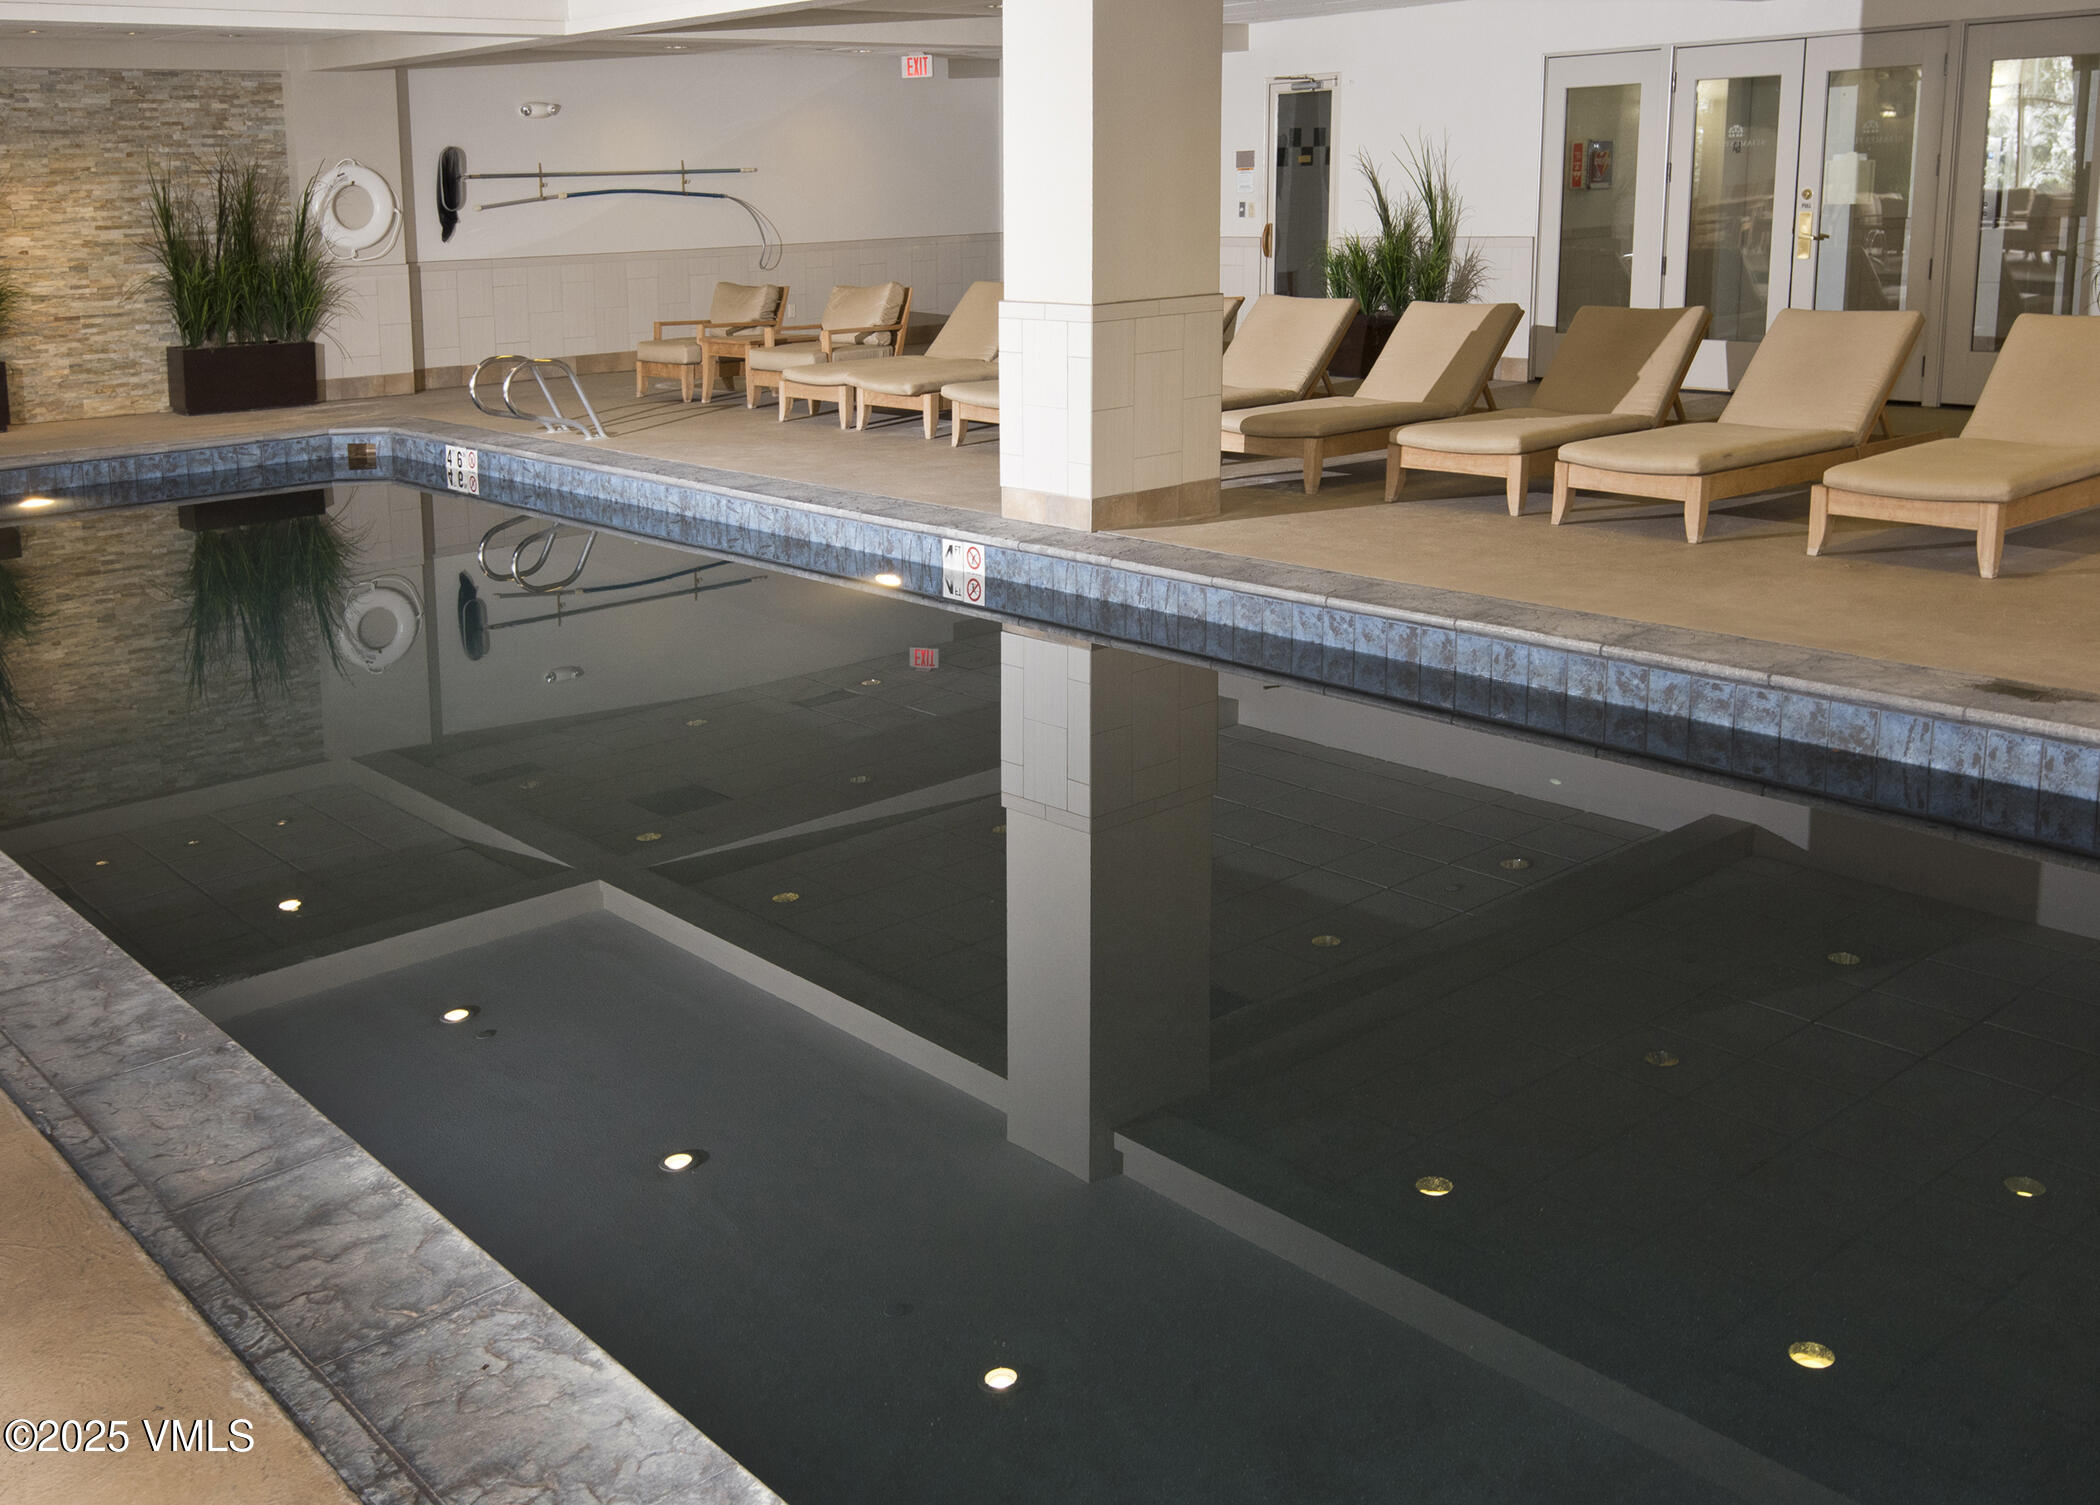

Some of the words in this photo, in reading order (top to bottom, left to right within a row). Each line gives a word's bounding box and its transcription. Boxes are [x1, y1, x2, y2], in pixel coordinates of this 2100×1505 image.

[906, 56, 928, 77] EXIT
[447, 449, 452, 466] 4
[457, 451, 463, 468] 6
